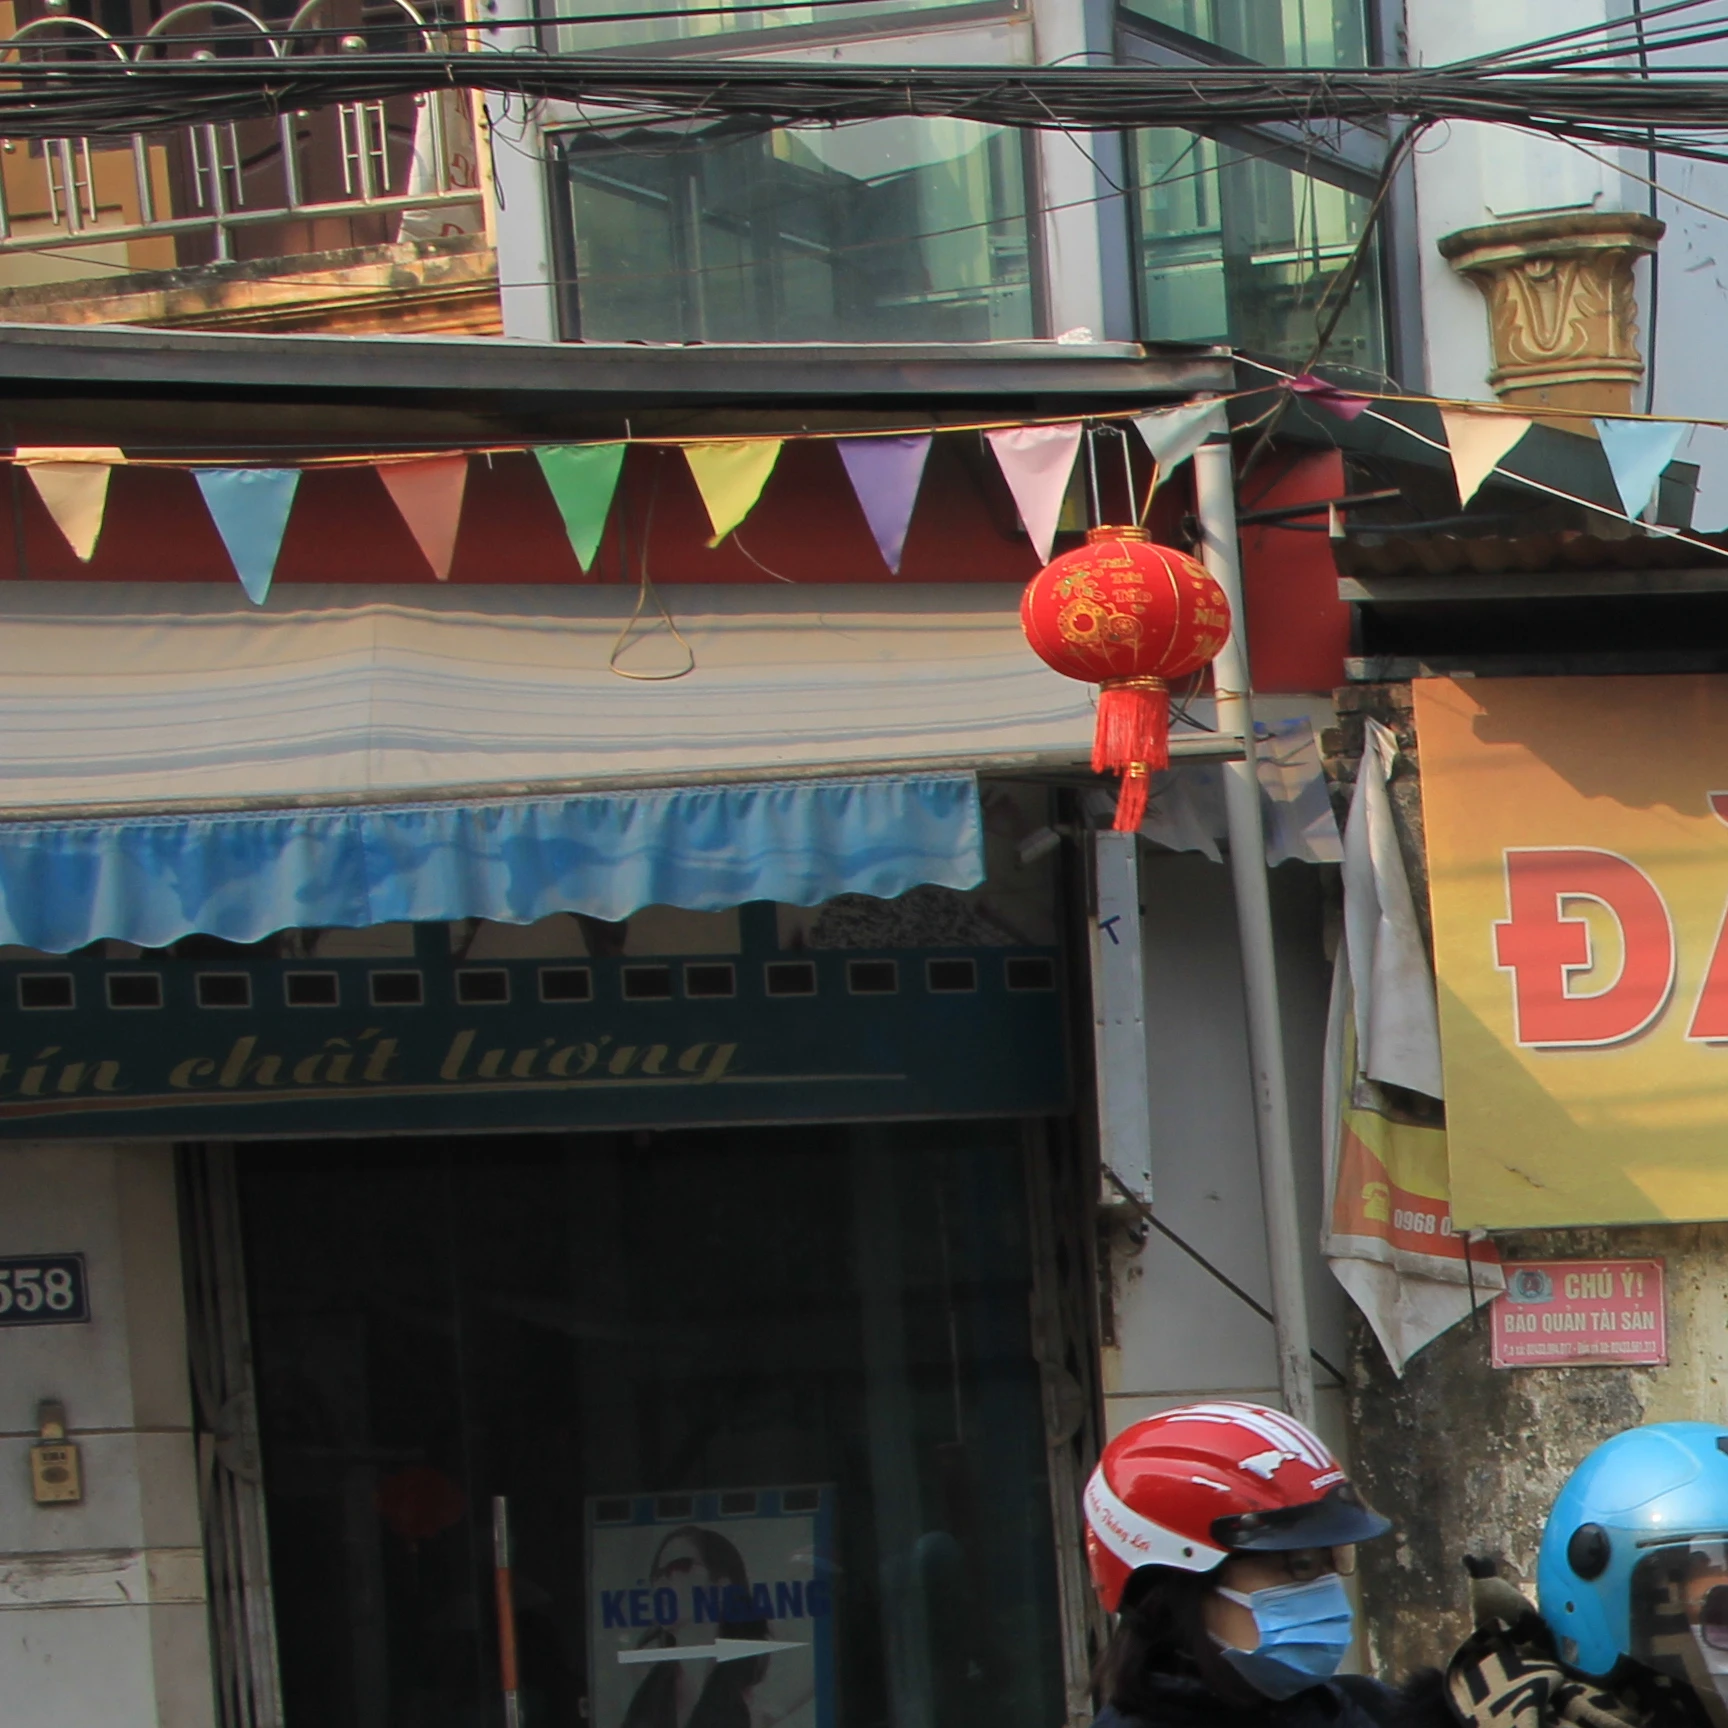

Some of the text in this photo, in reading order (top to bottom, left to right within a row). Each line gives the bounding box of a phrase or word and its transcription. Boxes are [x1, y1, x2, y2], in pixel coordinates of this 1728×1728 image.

[1393, 1208, 1436, 1235] 0968
[1564, 1266, 1644, 1300] CHÚ Ý!
[1504, 1303, 1656, 1334] BẢO QUẢN TÀI SẢN
